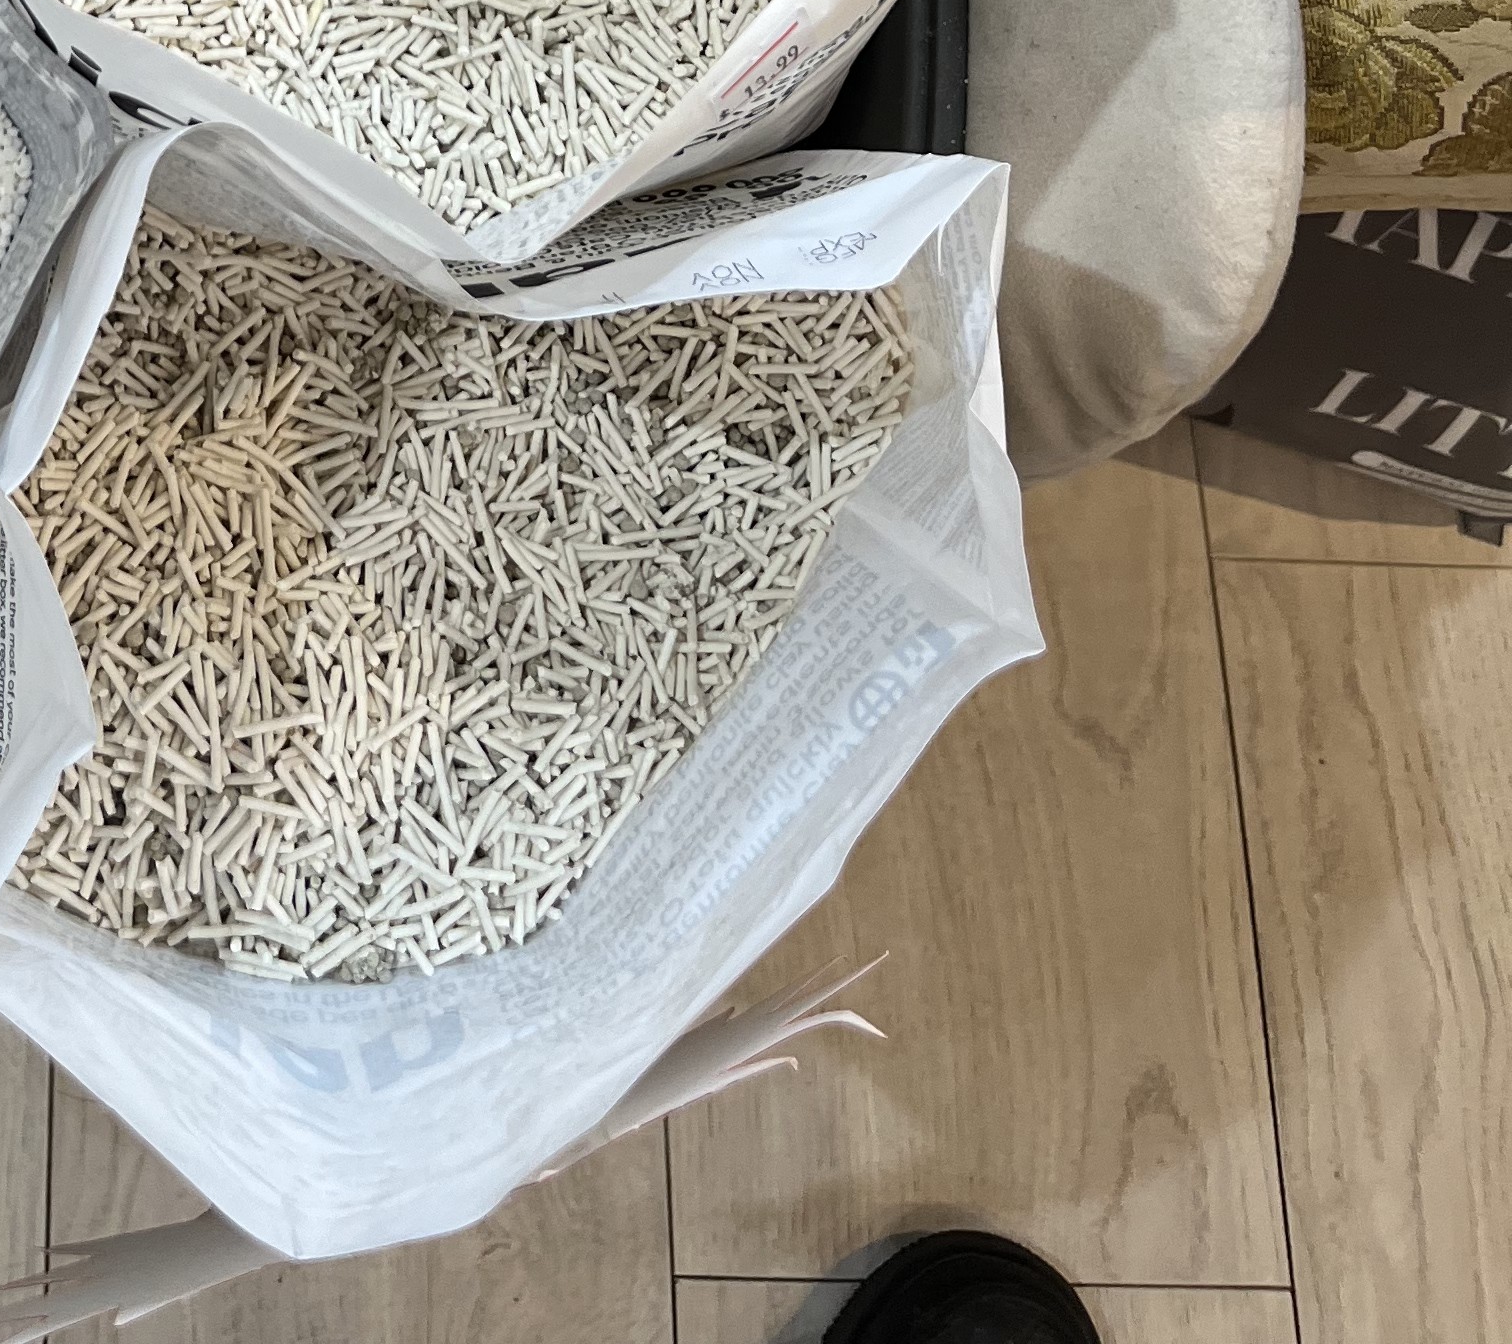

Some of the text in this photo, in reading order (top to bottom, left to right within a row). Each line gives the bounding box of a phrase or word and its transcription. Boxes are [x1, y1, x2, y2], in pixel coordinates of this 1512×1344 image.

[744, 44, 800, 99] 13.99
[0, 539, 7, 573] litter
[0, 615, 5, 639] we
[5, 601, 16, 740] the most of your
